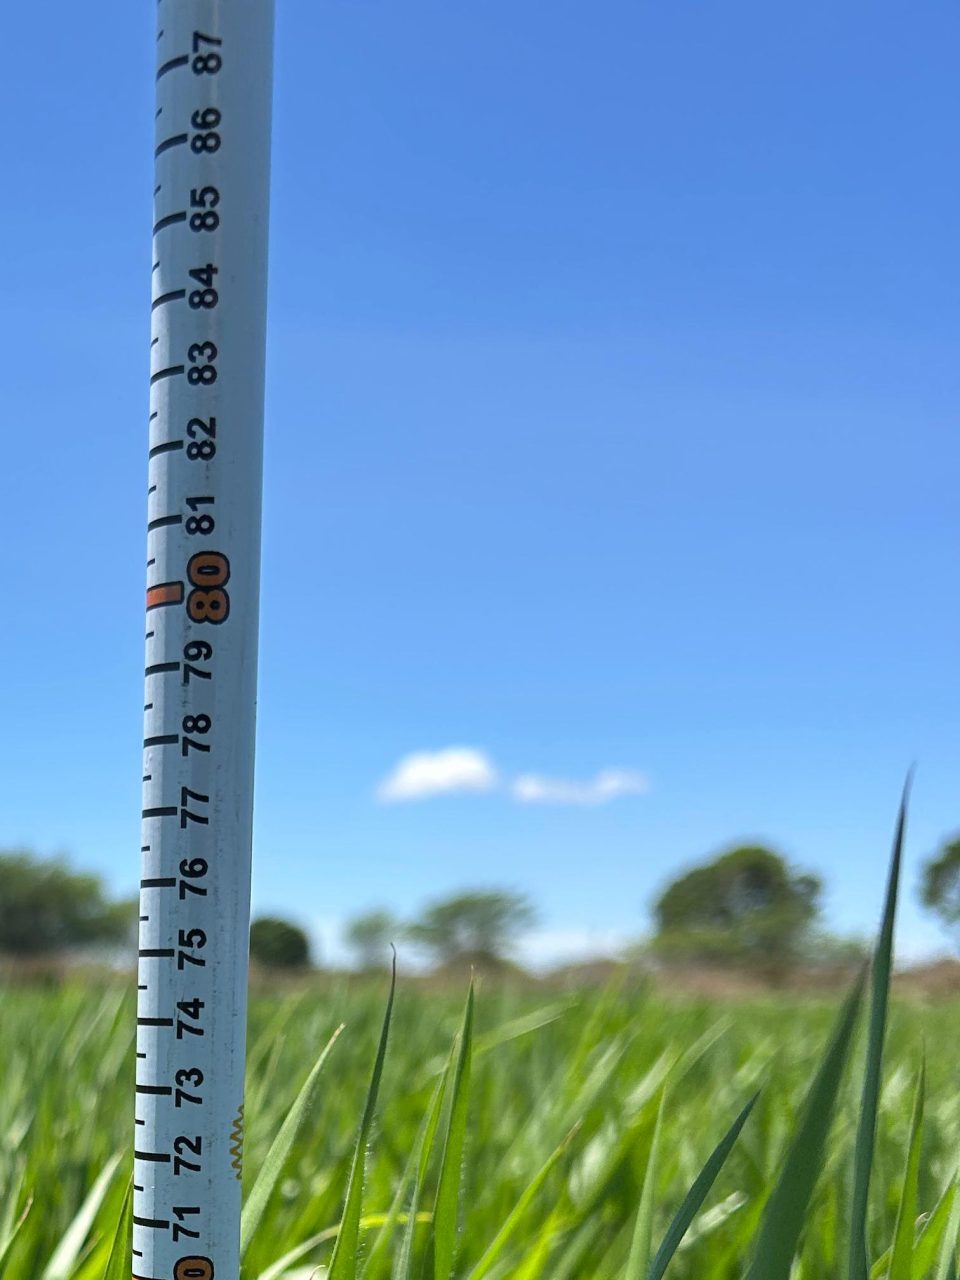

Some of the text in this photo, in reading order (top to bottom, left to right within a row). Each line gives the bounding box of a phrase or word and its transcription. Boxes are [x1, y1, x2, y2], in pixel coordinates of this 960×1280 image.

[192, 31, 222, 75] 87
[190, 108, 221, 154] 86
[190, 186, 220, 232] 85
[189, 263, 218, 309] 84
[187, 341, 217, 385] 83
[186, 417, 216, 461] 82
[185, 496, 214, 535] 81
[186, 551, 230, 625] 80
[181, 640, 212, 686] 79
[182, 714, 211, 756] 78
[181, 787, 209, 828] 77
[179, 858, 208, 900] 76
[178, 928, 207, 970] 75
[177, 998, 204, 1039] 74
[175, 1068, 204, 1107] 73
[174, 1136, 202, 1175] 72
[173, 1207, 200, 1242] 71
